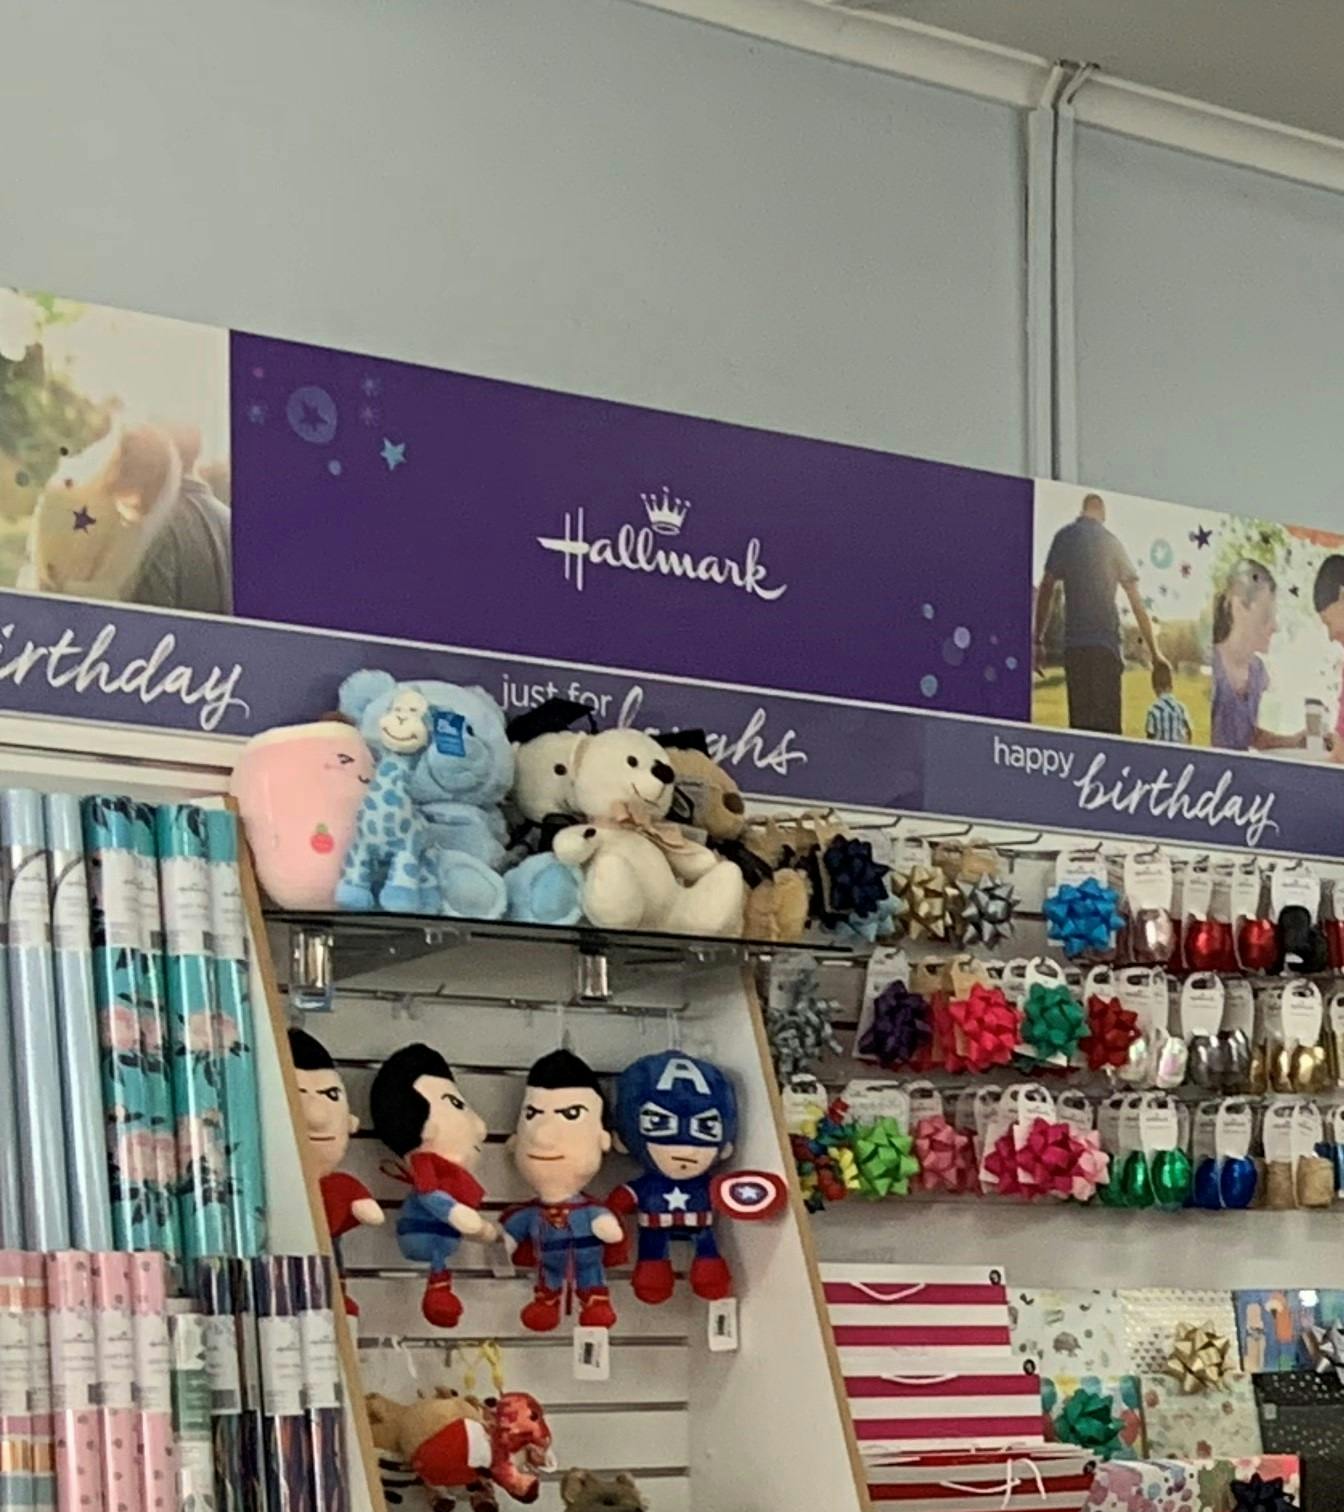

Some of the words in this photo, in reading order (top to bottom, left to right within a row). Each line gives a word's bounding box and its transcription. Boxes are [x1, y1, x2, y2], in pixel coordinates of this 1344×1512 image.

[537, 503, 790, 600] Hallmark
[500, 672, 560, 710] just
[567, 682, 613, 717] for
[617, 684, 809, 776] lghs
[993, 735, 1075, 780] happy
[1073, 750, 1281, 847] birthday
